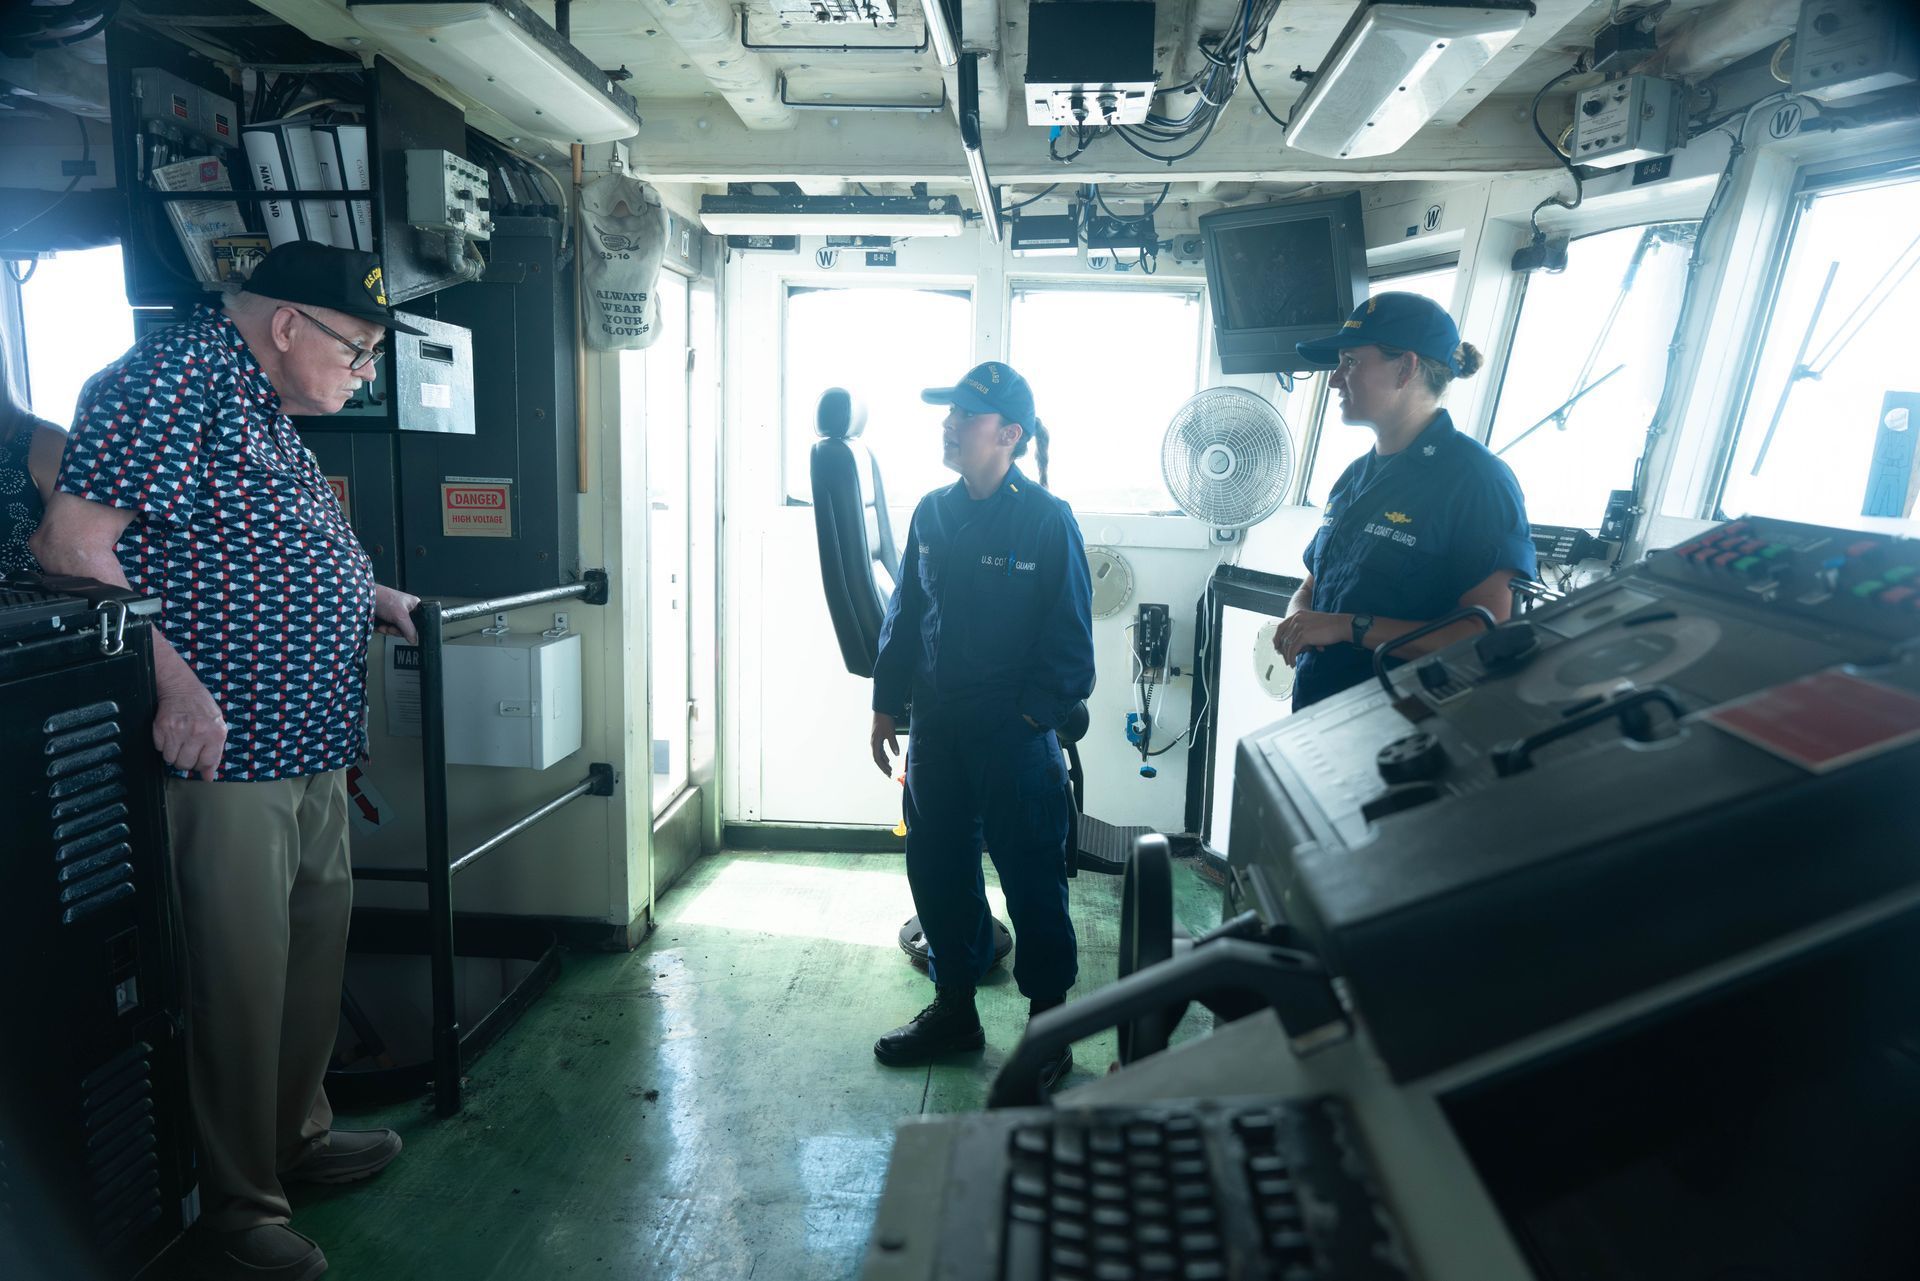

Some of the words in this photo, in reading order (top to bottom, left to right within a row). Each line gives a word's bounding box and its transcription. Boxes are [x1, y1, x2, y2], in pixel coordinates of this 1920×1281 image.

[1776, 108, 1798, 134] W
[259, 166, 273, 185] NAV
[263, 186, 280, 218] SAND
[1427, 209, 1440, 228] W
[818, 251, 833, 266] W
[595, 290, 648, 302] ALWAYS
[600, 302, 643, 314] WEAR
[604, 314, 643, 325] YOUR
[602, 323, 650, 336] GLOVES
[455, 493, 498, 505] DANGER
[452, 515, 471, 524] HIGH
[473, 515, 503, 524] VOLTAGE
[1374, 525, 1394, 538] COAST
[1392, 531, 1416, 547] GUARD
[981, 555, 993, 565] U.S.
[1015, 561, 1036, 571] GUARD
